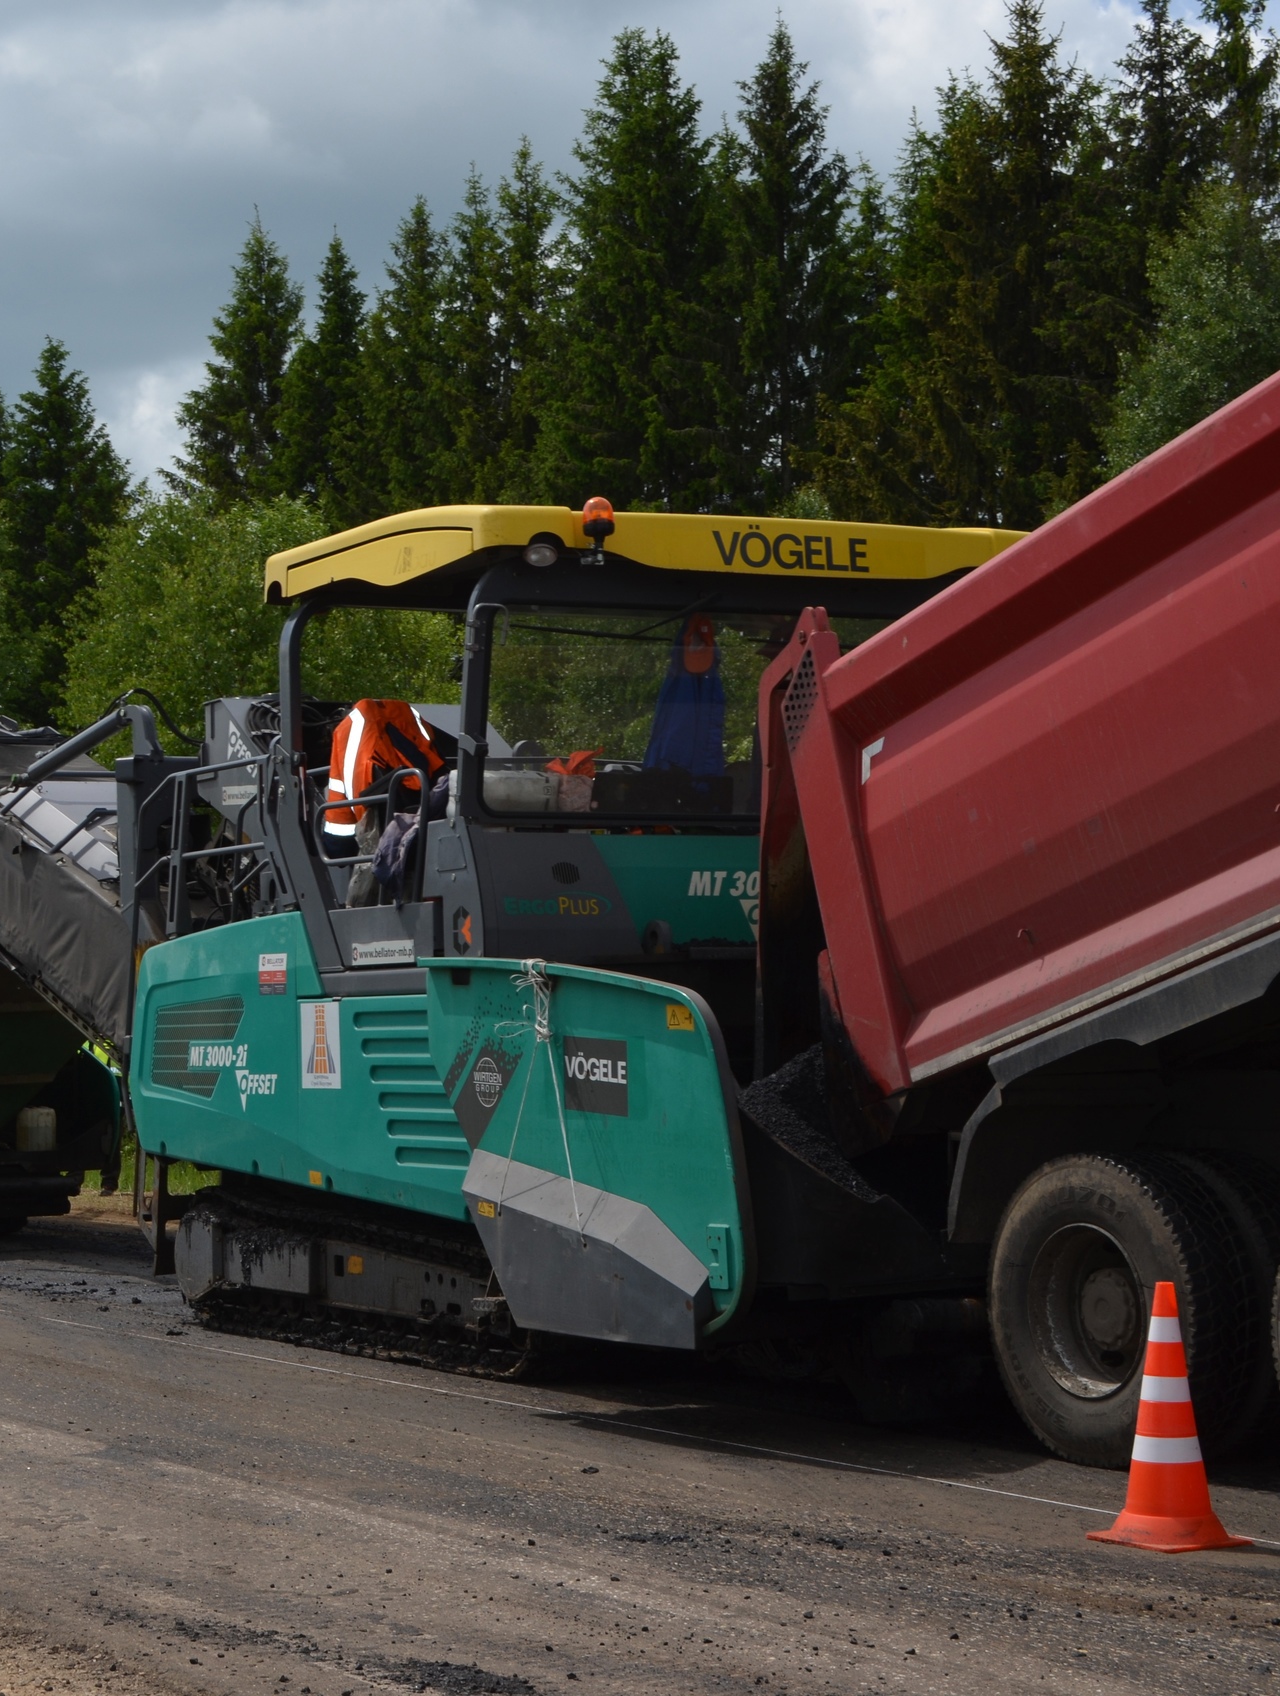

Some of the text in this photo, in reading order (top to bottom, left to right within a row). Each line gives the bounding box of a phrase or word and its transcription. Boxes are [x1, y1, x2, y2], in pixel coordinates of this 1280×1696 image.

[712, 524, 869, 573] VÖGELE
[688, 871, 727, 897] MT
[189, 1043, 248, 1067] MT 3000-2i
[473, 1071, 502, 1083] WIRTGEN
[564, 1052, 627, 1085] VÖGELE
[236, 1071, 278, 1096] OFFSET
[475, 1083, 500, 1093] GROUP
